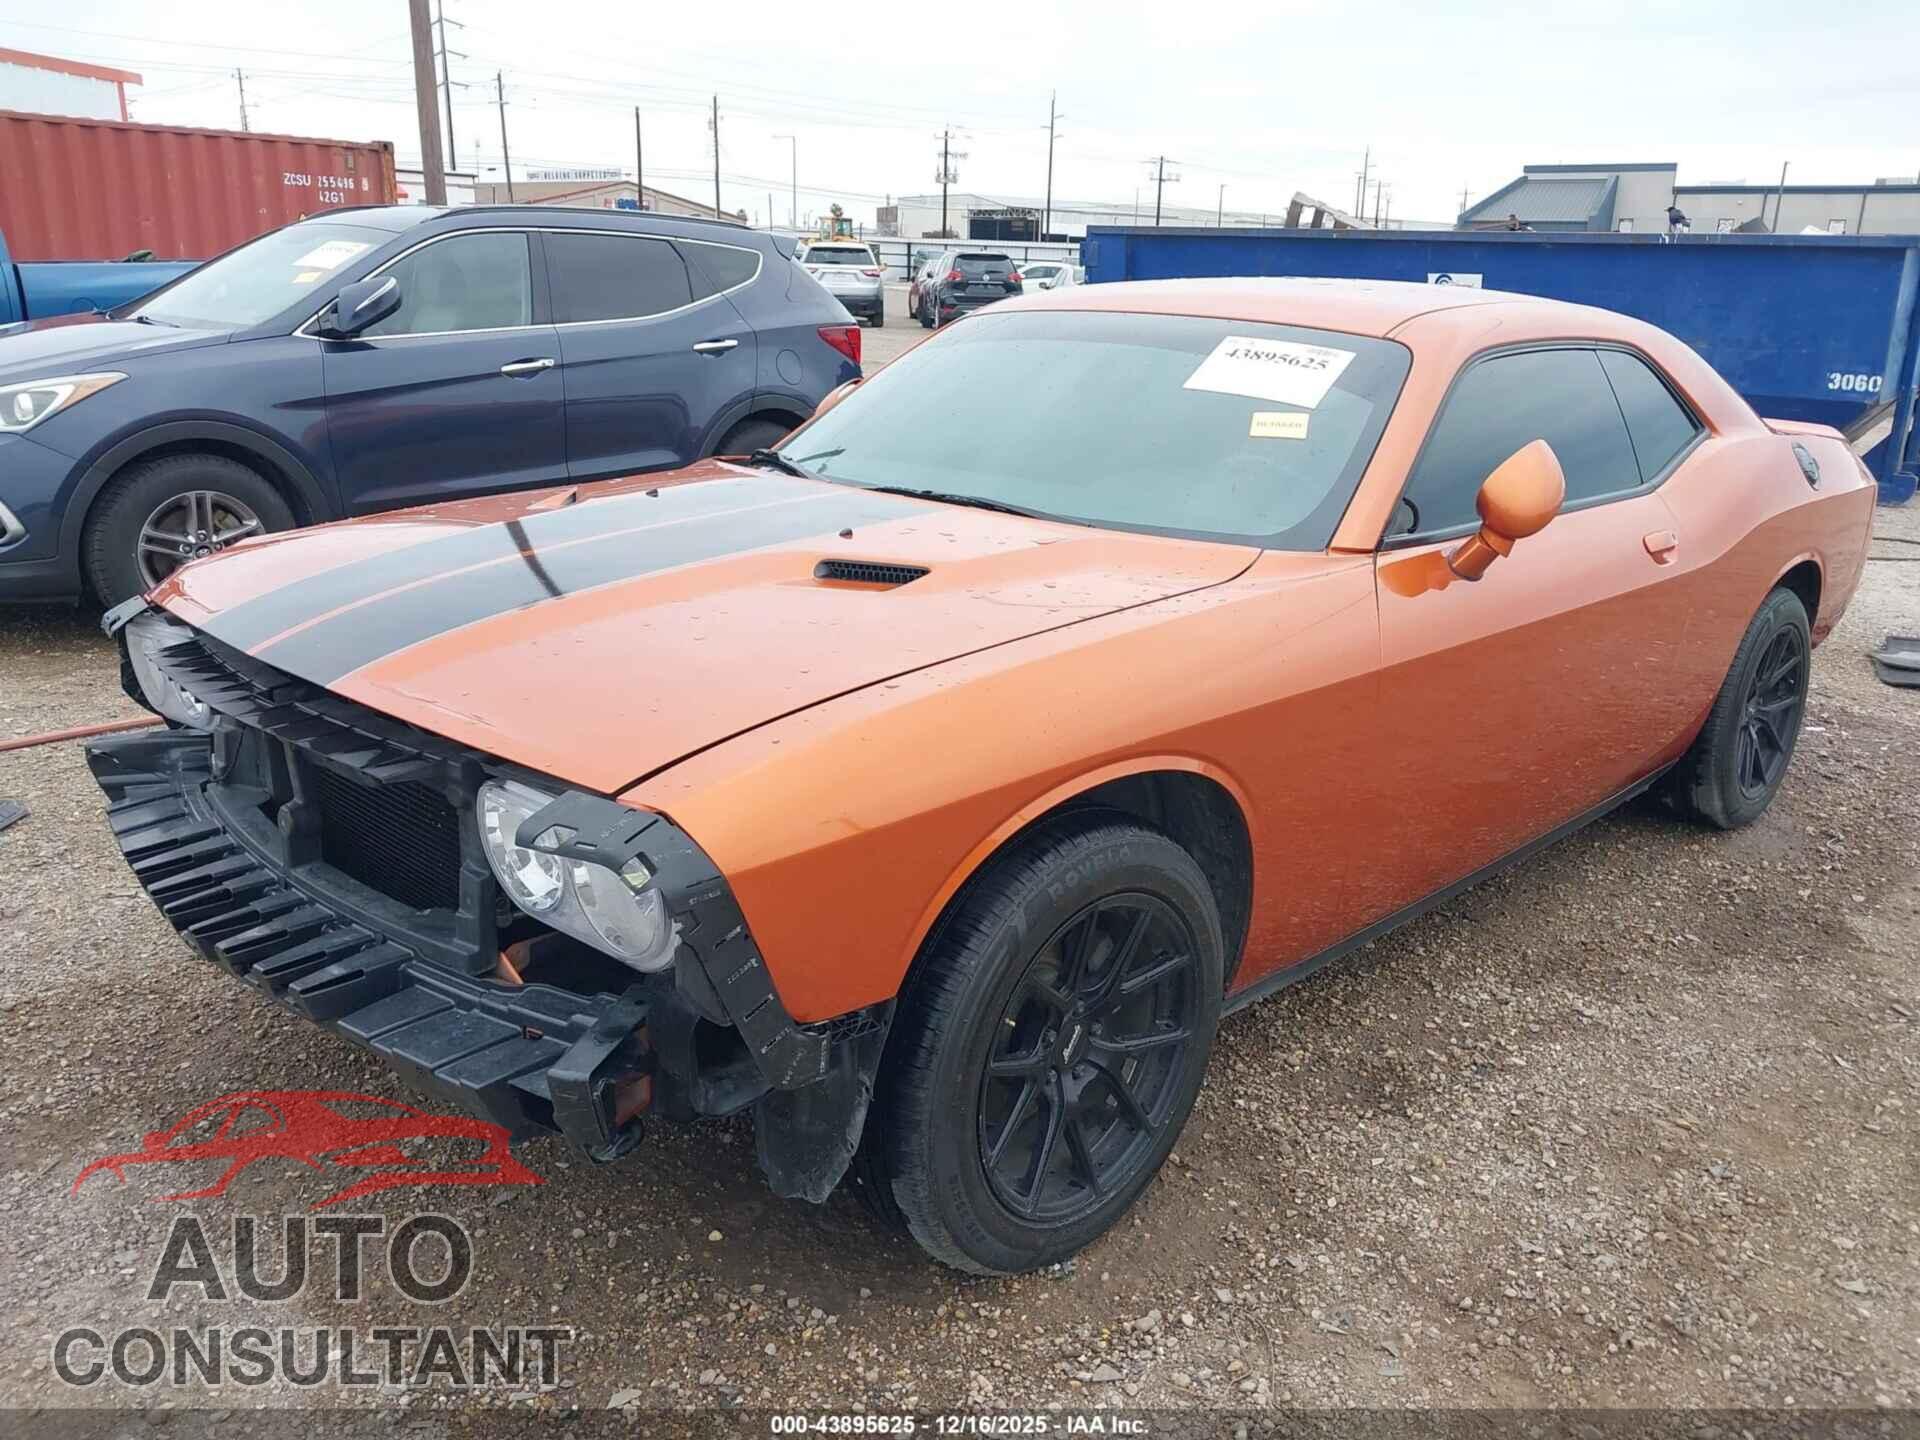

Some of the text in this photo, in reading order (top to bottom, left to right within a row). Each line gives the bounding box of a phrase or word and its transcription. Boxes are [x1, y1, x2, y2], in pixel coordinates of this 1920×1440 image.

[283, 172, 311, 186] ZCSU
[1225, 348, 1329, 370] 43895625
[1827, 372, 1883, 393] 3060
